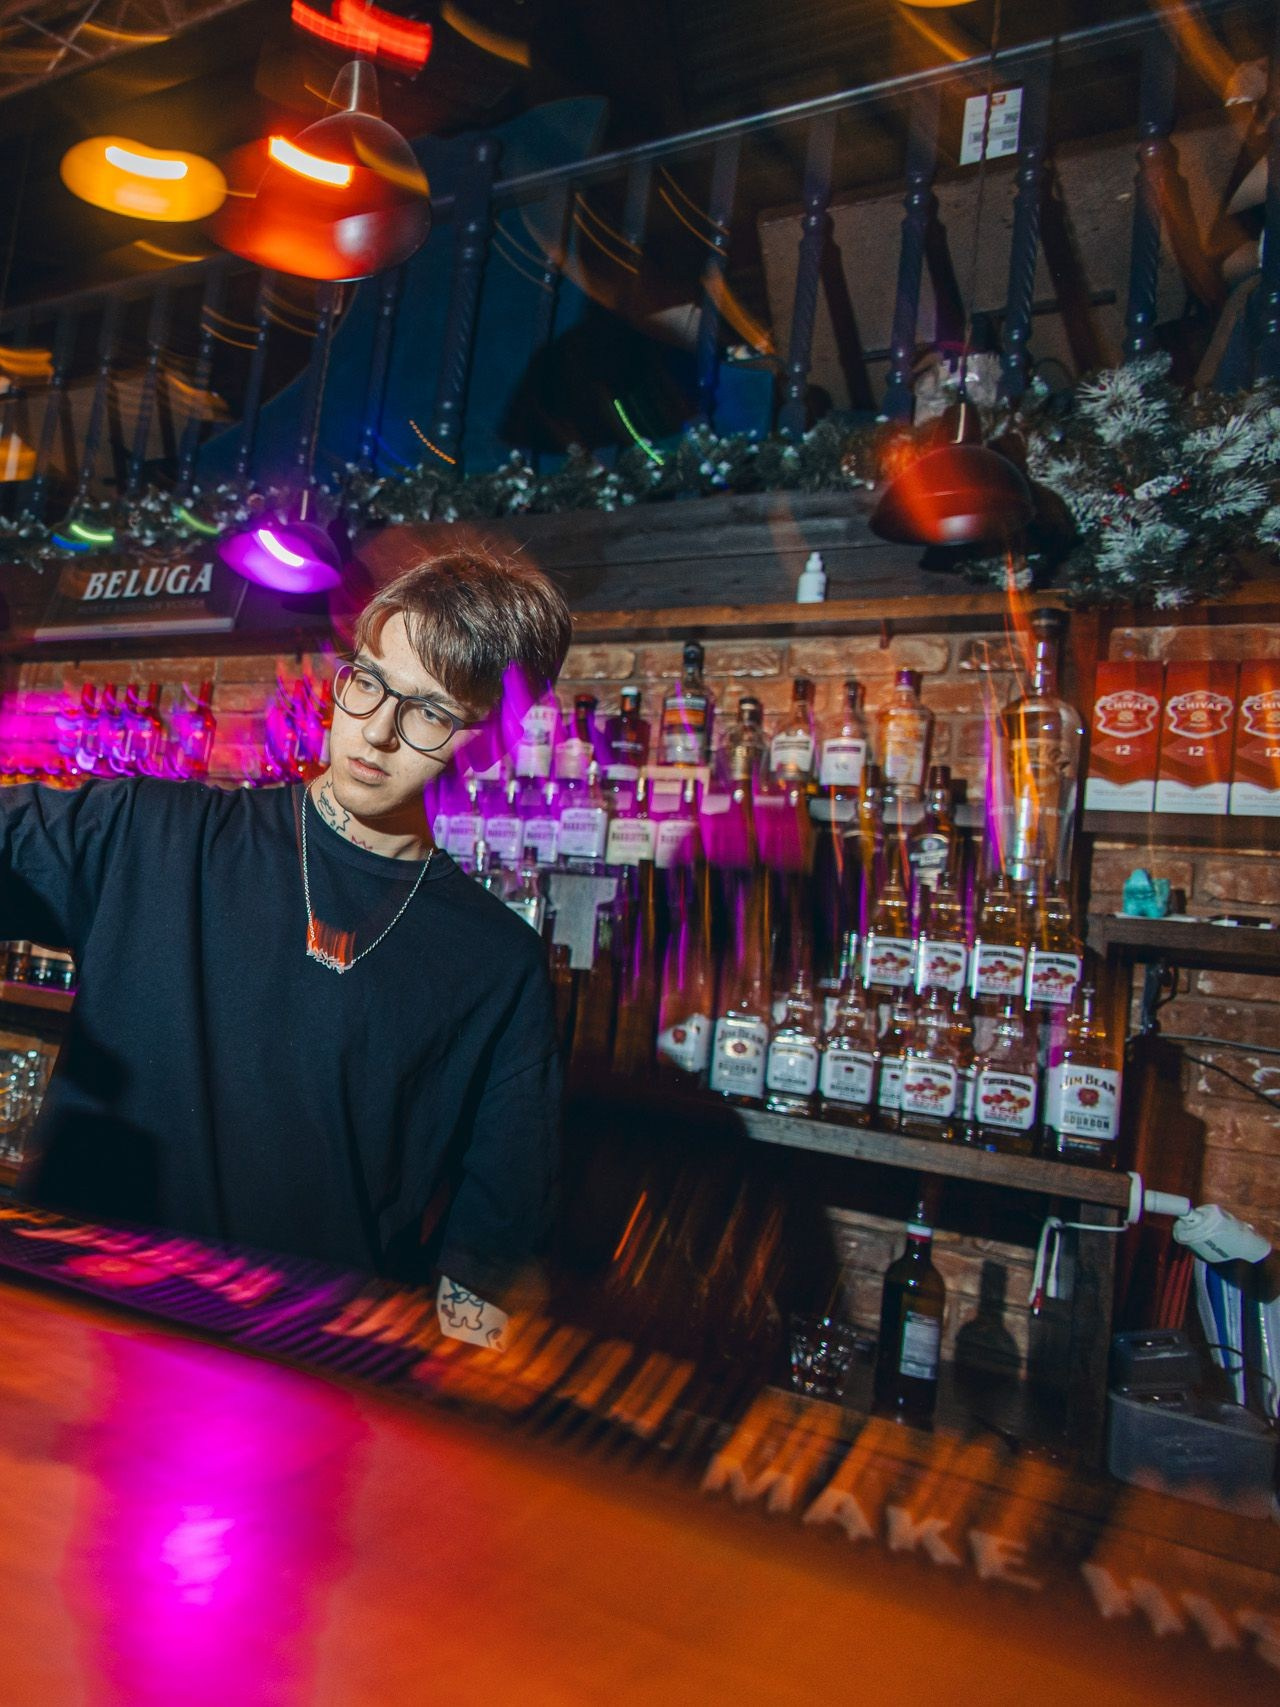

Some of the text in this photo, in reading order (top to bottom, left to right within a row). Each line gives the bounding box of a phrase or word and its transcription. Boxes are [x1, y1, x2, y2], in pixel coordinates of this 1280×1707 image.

[81, 562, 214, 600] BELUGA
[1105, 701, 1149, 711] CHIVAS
[1177, 701, 1222, 711] CHIVAS
[1115, 744, 1131, 756] 12
[1187, 745, 1205, 757] 12
